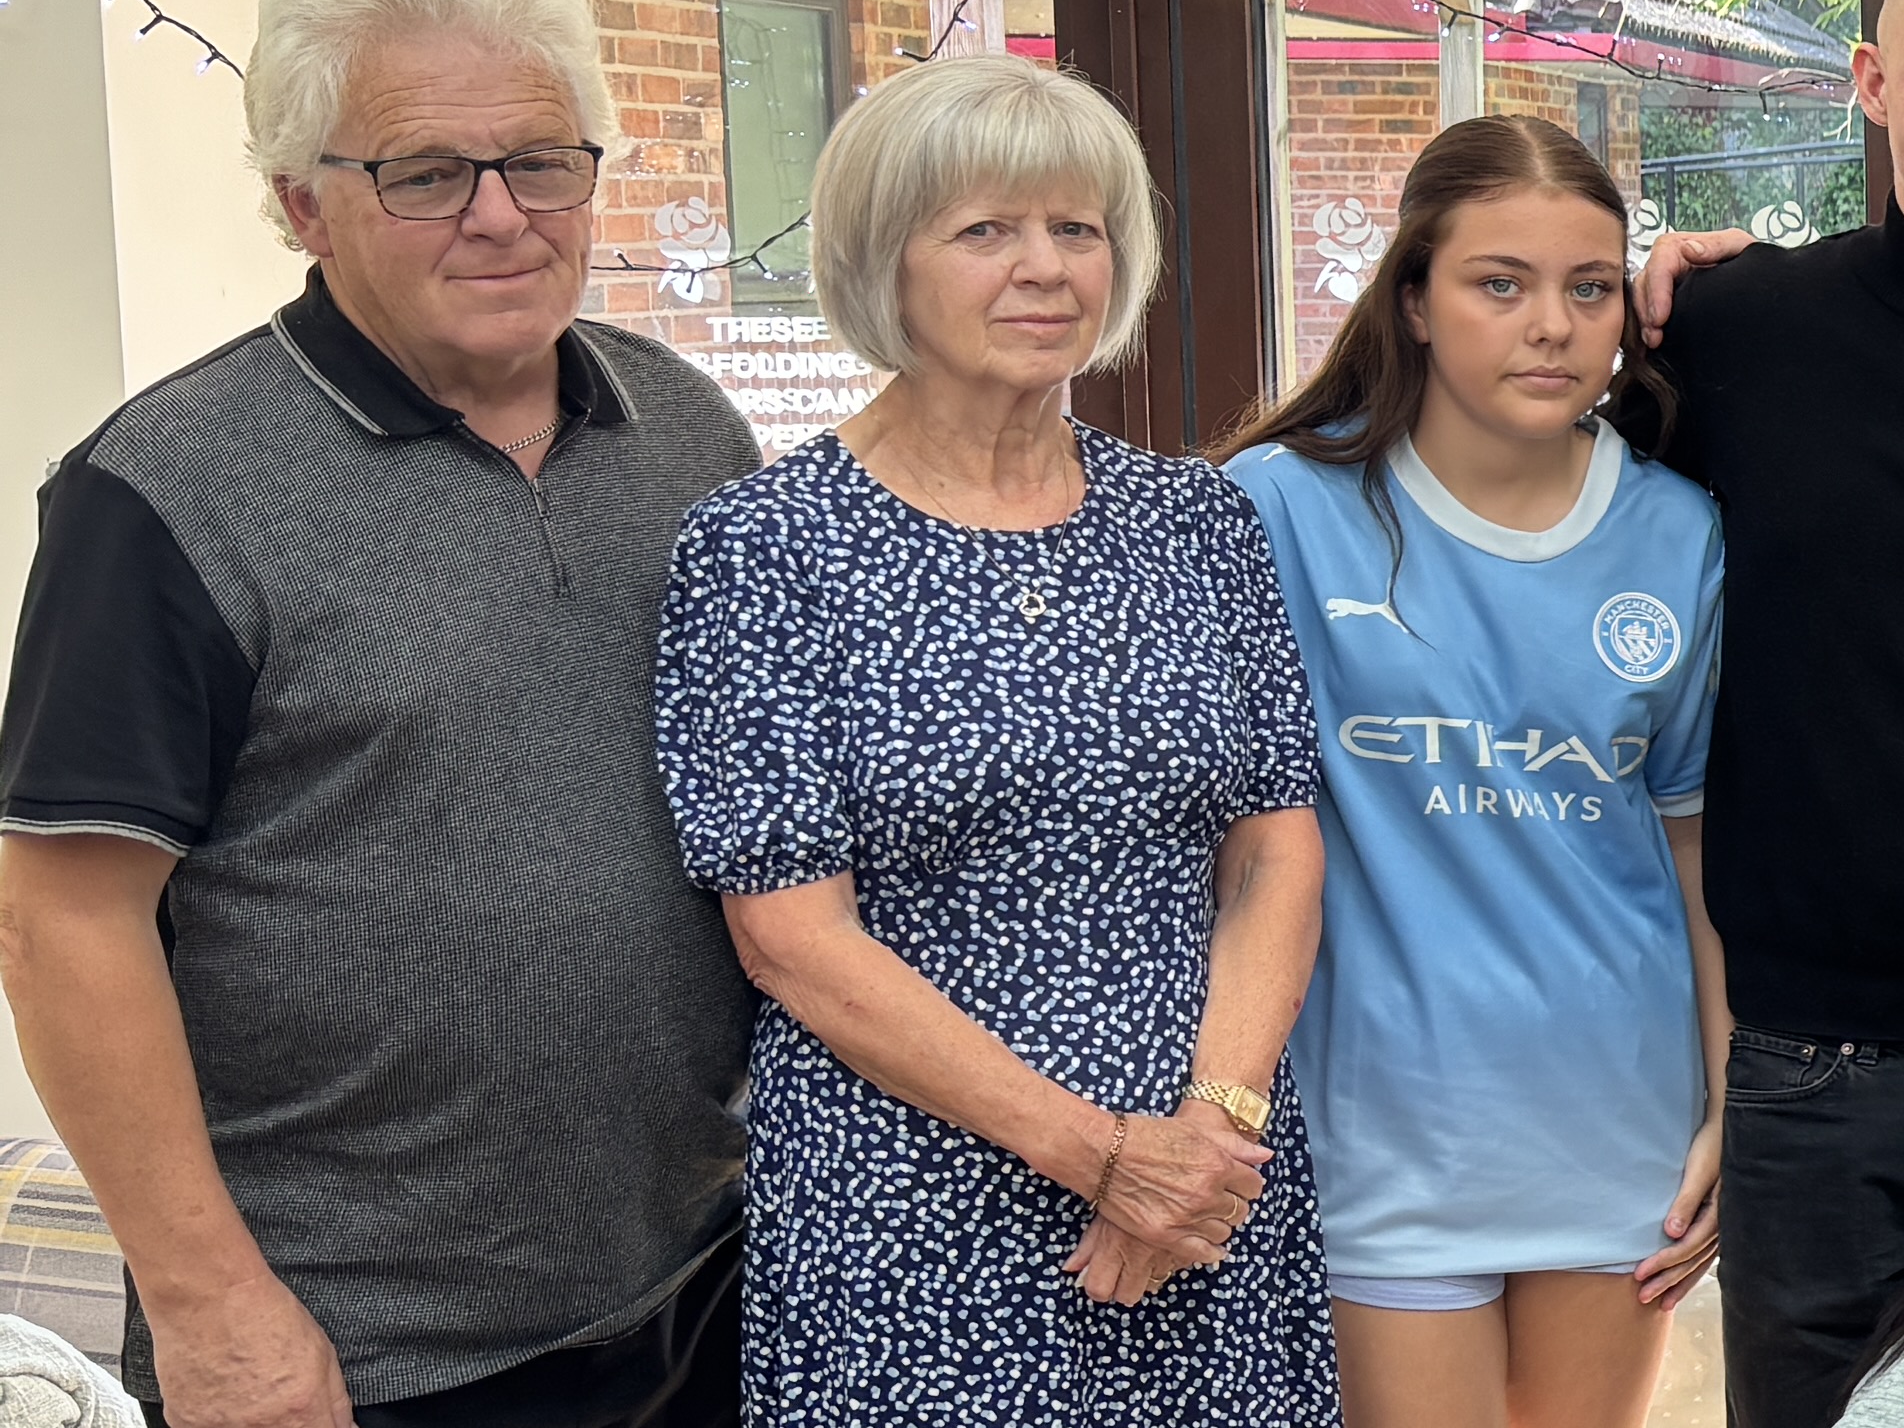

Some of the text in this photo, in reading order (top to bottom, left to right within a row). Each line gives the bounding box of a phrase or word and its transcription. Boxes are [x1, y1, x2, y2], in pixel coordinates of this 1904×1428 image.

[1603, 600, 1670, 630] MANCHESTER
[1624, 664, 1650, 675] CITY
[1338, 714, 1649, 783] ETIHAD
[1424, 783, 1603, 822] AIRWAYS
